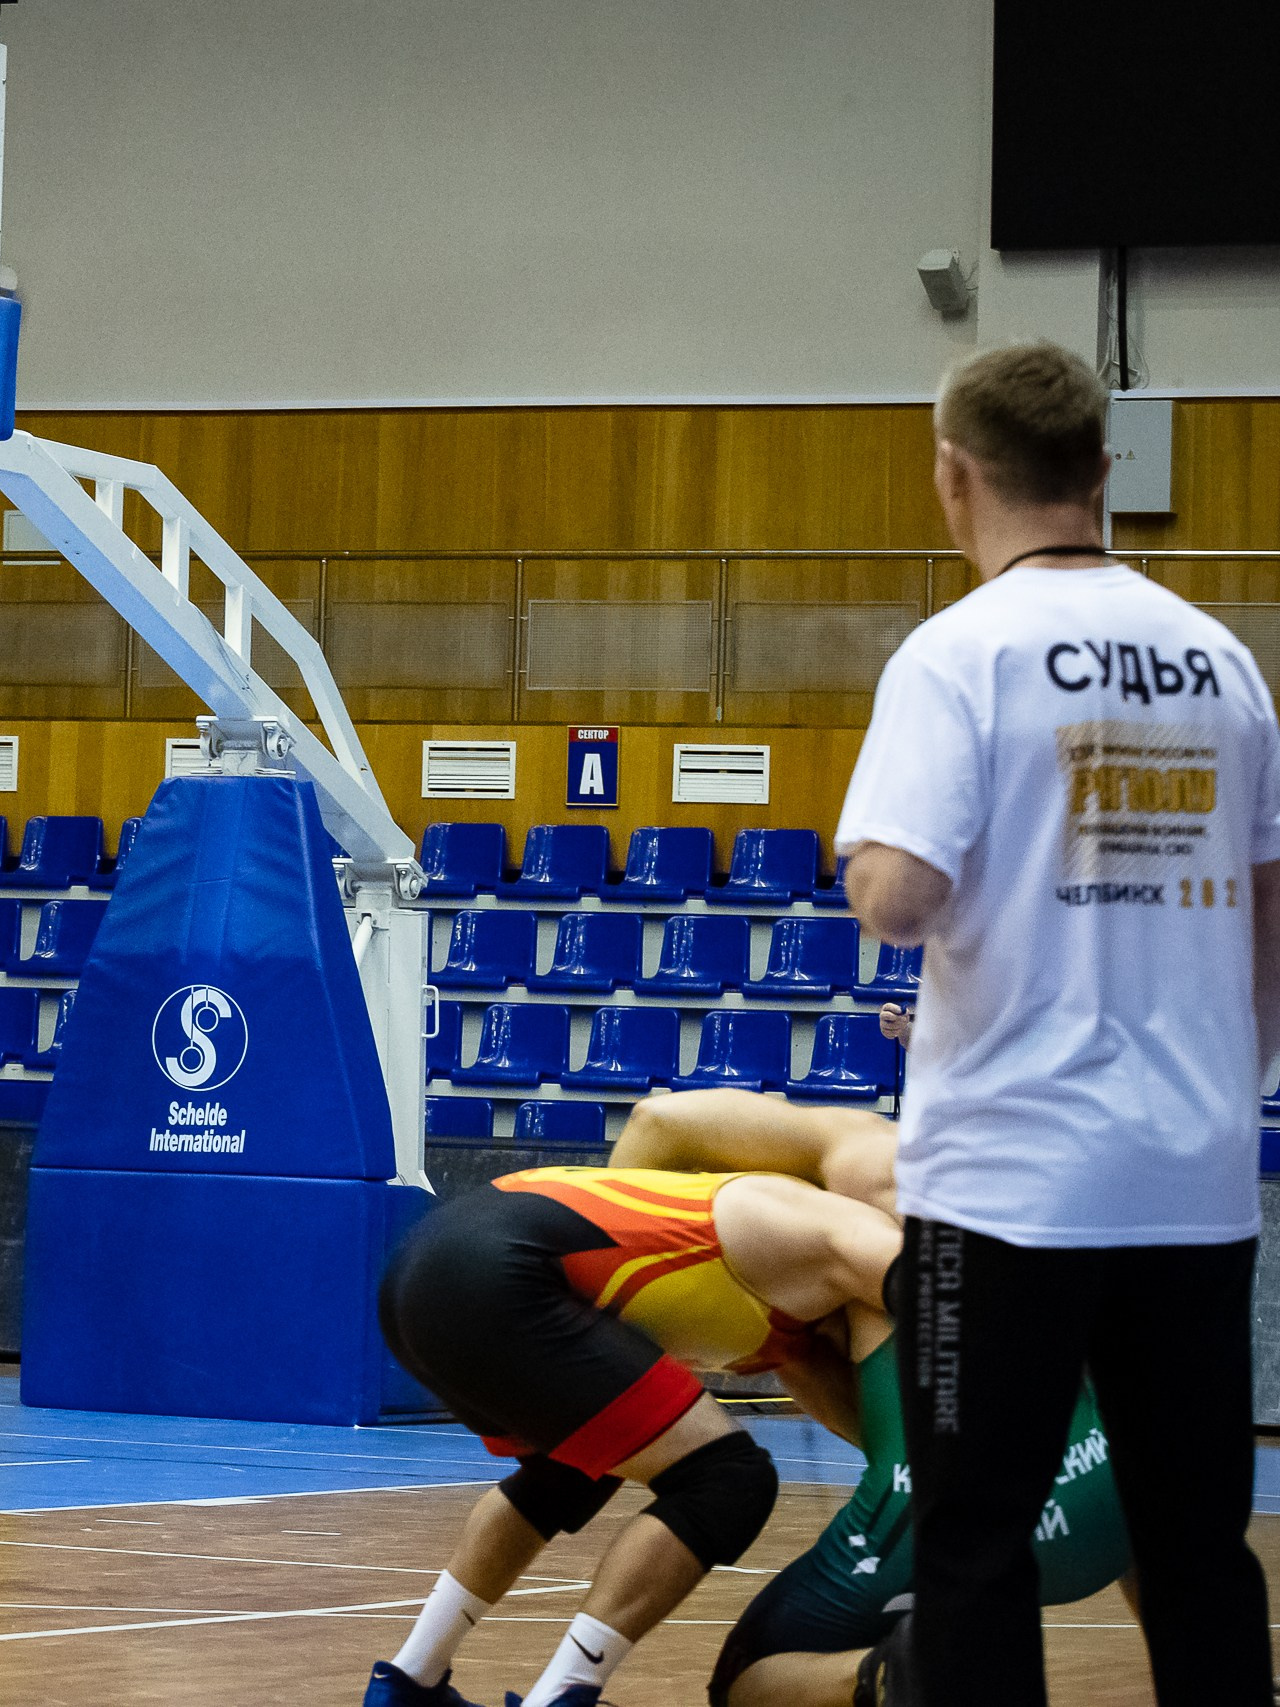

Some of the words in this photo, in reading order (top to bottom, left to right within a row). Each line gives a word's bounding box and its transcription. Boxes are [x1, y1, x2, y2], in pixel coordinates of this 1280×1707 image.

[1046, 640, 1221, 704] СУДЬЯ
[578, 729, 609, 739] СЕКТОР
[579, 753, 604, 794] А
[168, 1101, 228, 1126] Schelde
[149, 1128, 246, 1153] International
[934, 1301, 962, 1433] MILITARE
